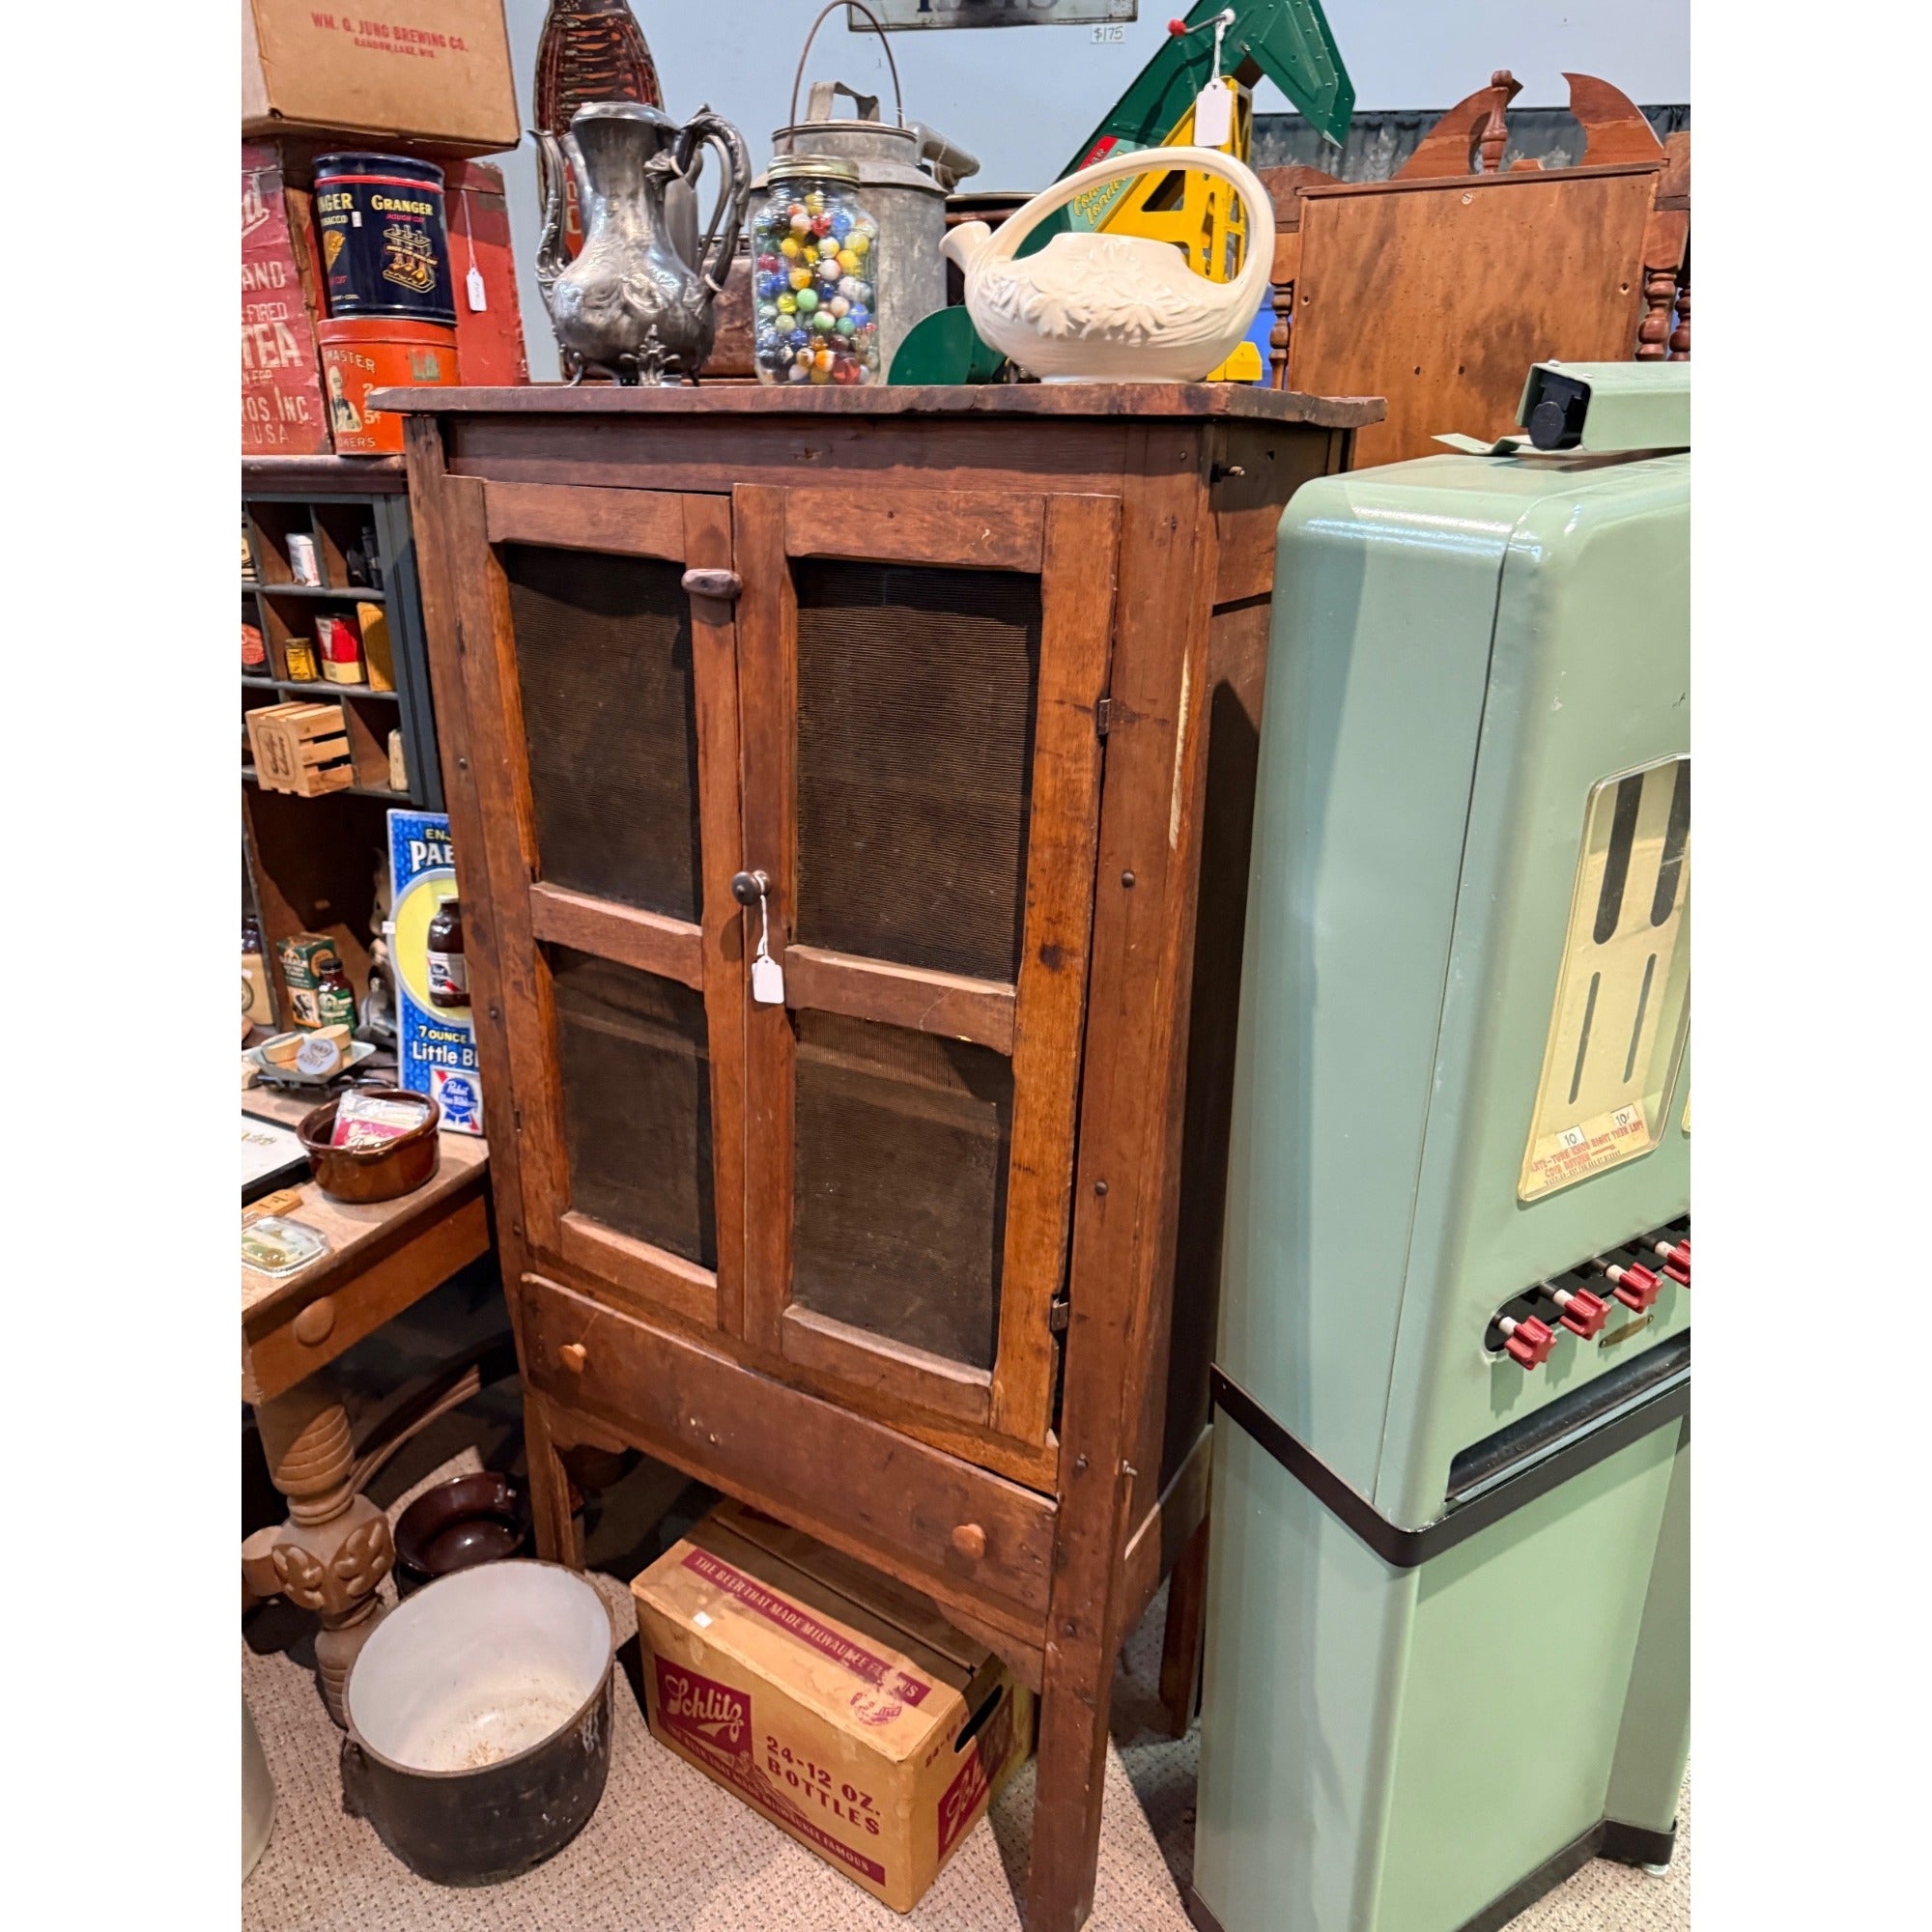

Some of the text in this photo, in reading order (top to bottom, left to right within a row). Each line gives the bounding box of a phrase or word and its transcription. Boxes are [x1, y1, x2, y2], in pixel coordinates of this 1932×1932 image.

[358, 19, 389, 39] JUNG
[393, 26, 446, 48] BREWING
[1093, 25, 1123, 43] $175
[371, 194, 434, 215] GRANGER
[242, 322, 304, 369] TEA
[412, 1040, 458, 1065] Little
[418, 1025, 468, 1043] 7 OUNCE
[694, 1555, 716, 1576] THE
[714, 1568, 746, 1594] BEER
[742, 1584, 772, 1608] THAT
[768, 1601, 802, 1628] MADE
[800, 1619, 868, 1667] MILWAUKEE
[665, 1674, 744, 1743] Schlitz
[766, 1735, 881, 1816] 24-12 OZ.
[768, 1756, 879, 1835] BOTTLES
[823, 1833, 867, 1873] FAMOUS
